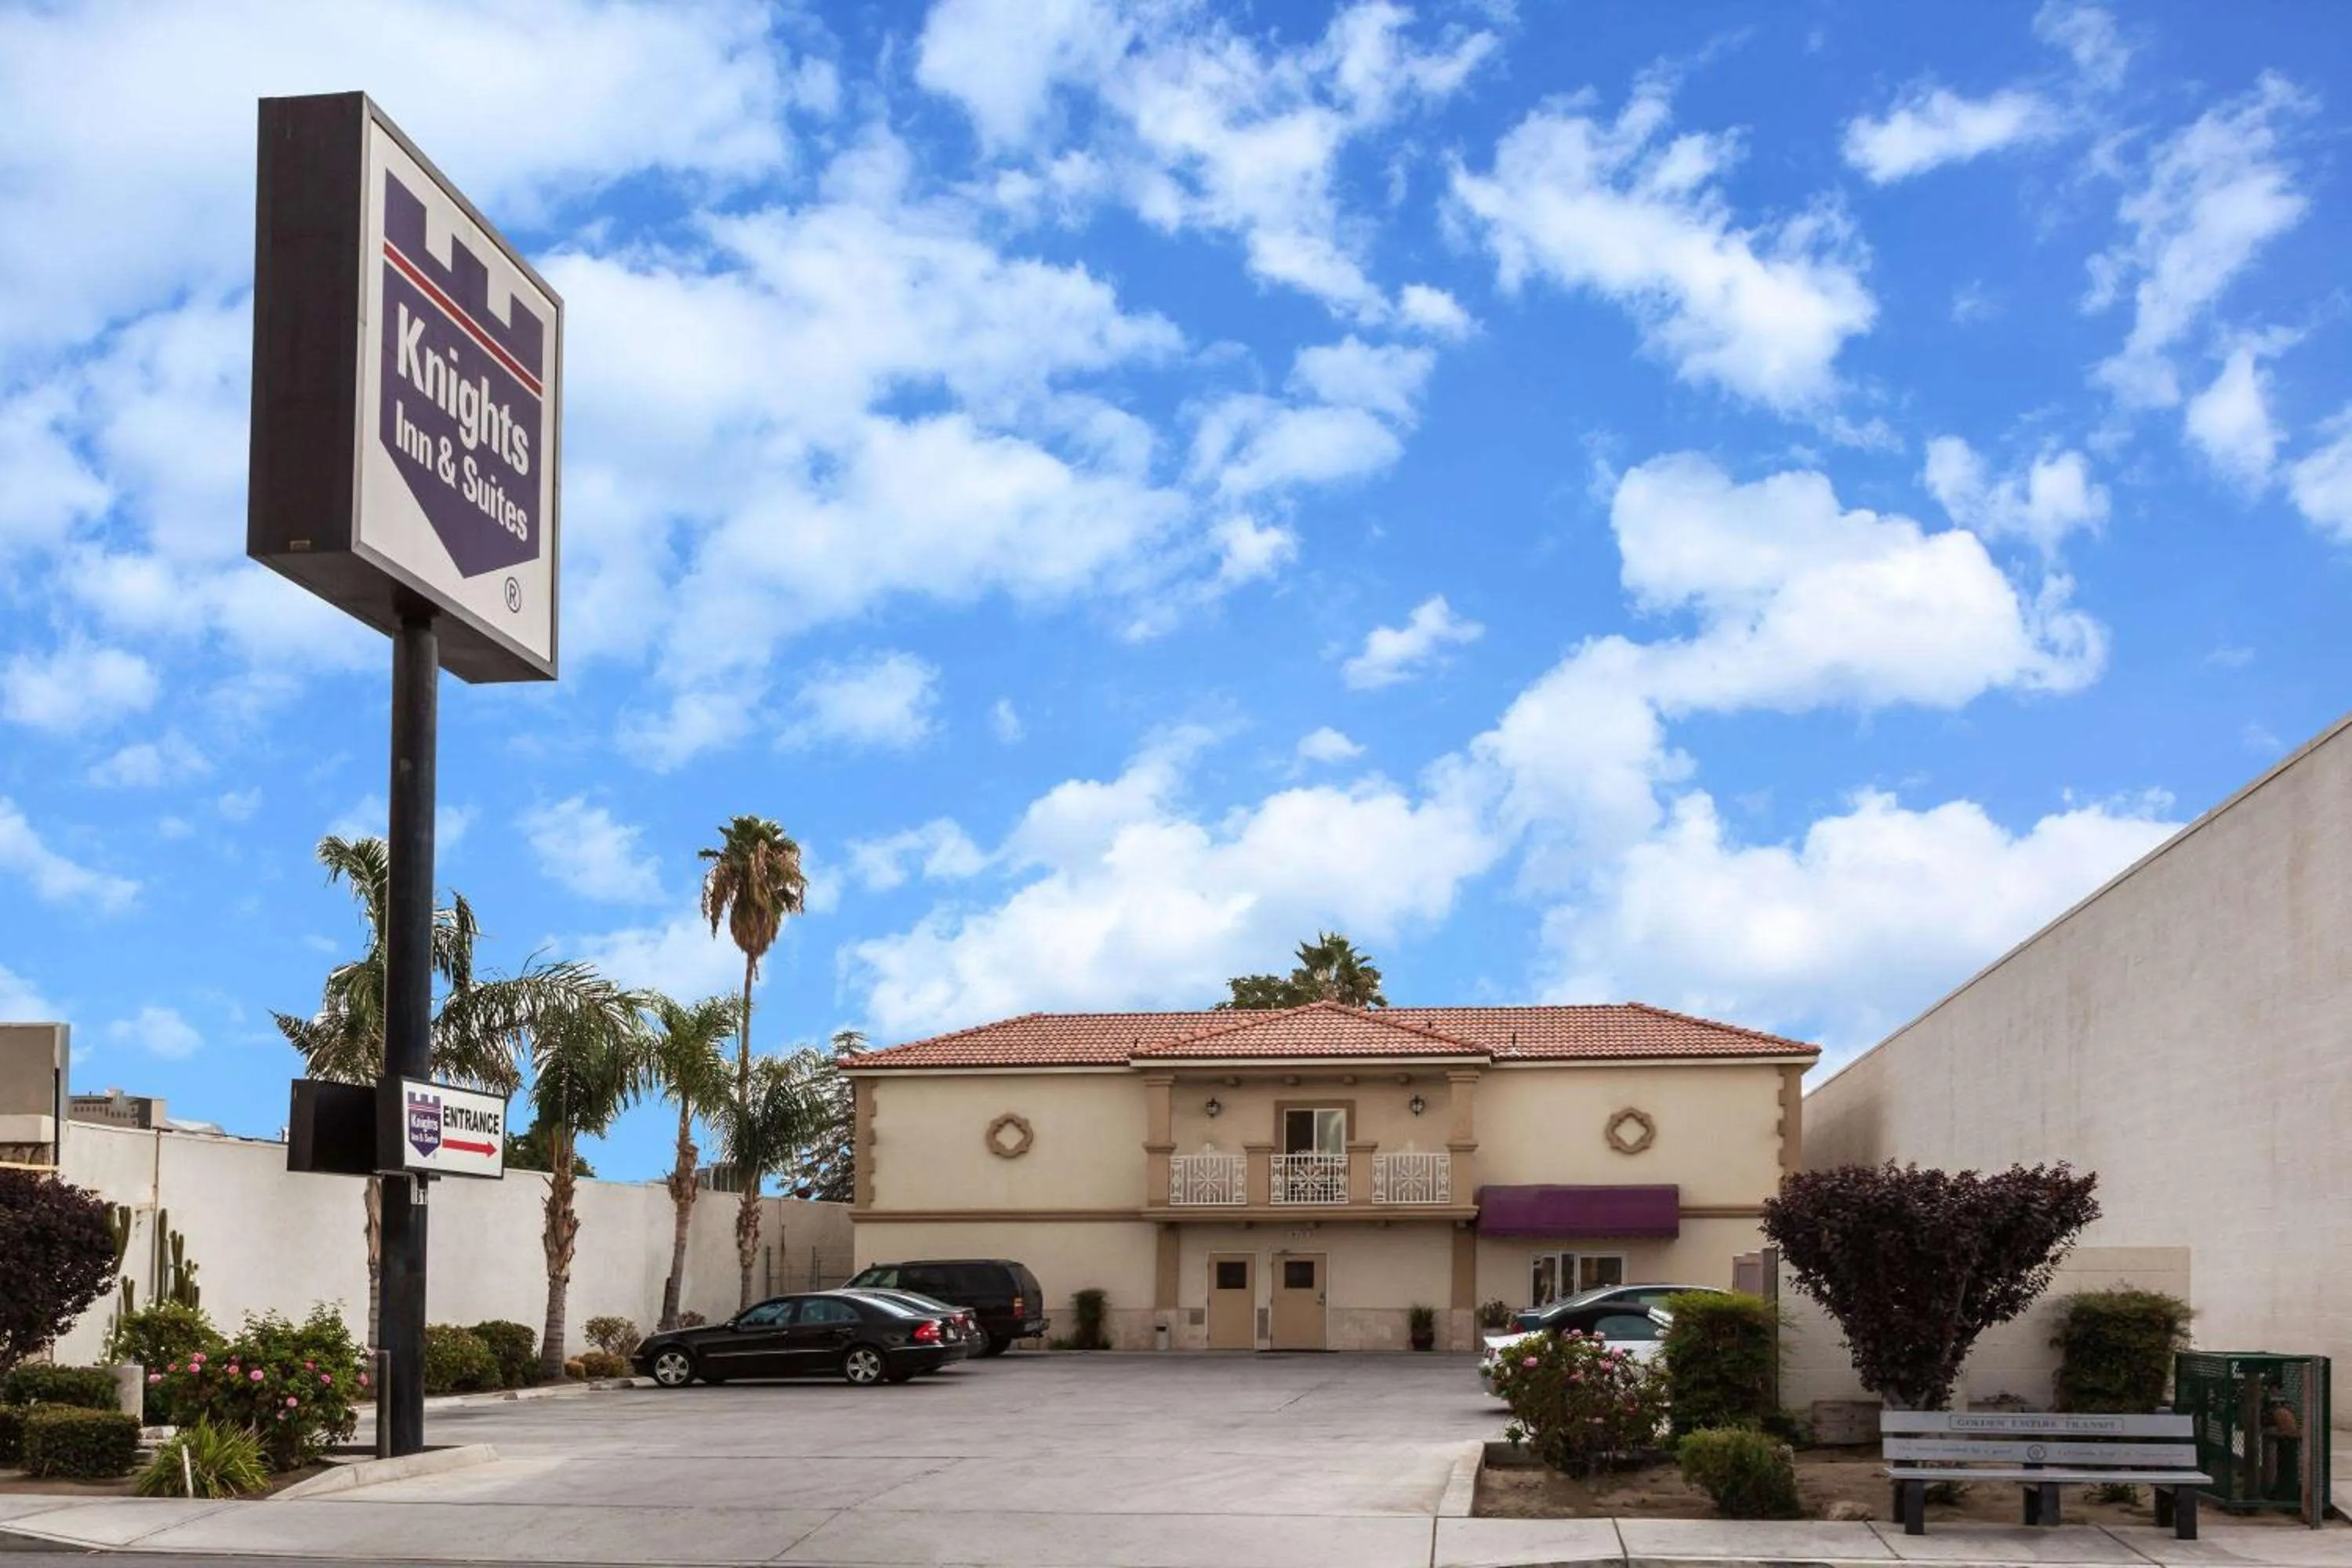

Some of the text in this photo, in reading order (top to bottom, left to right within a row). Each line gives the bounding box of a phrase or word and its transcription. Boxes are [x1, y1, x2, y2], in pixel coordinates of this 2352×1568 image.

[397, 302, 529, 476] Knights
[396, 399, 528, 542] Inn & Suites
[410, 1113, 439, 1131] Knights
[443, 1105, 499, 1134] ENTRANCE
